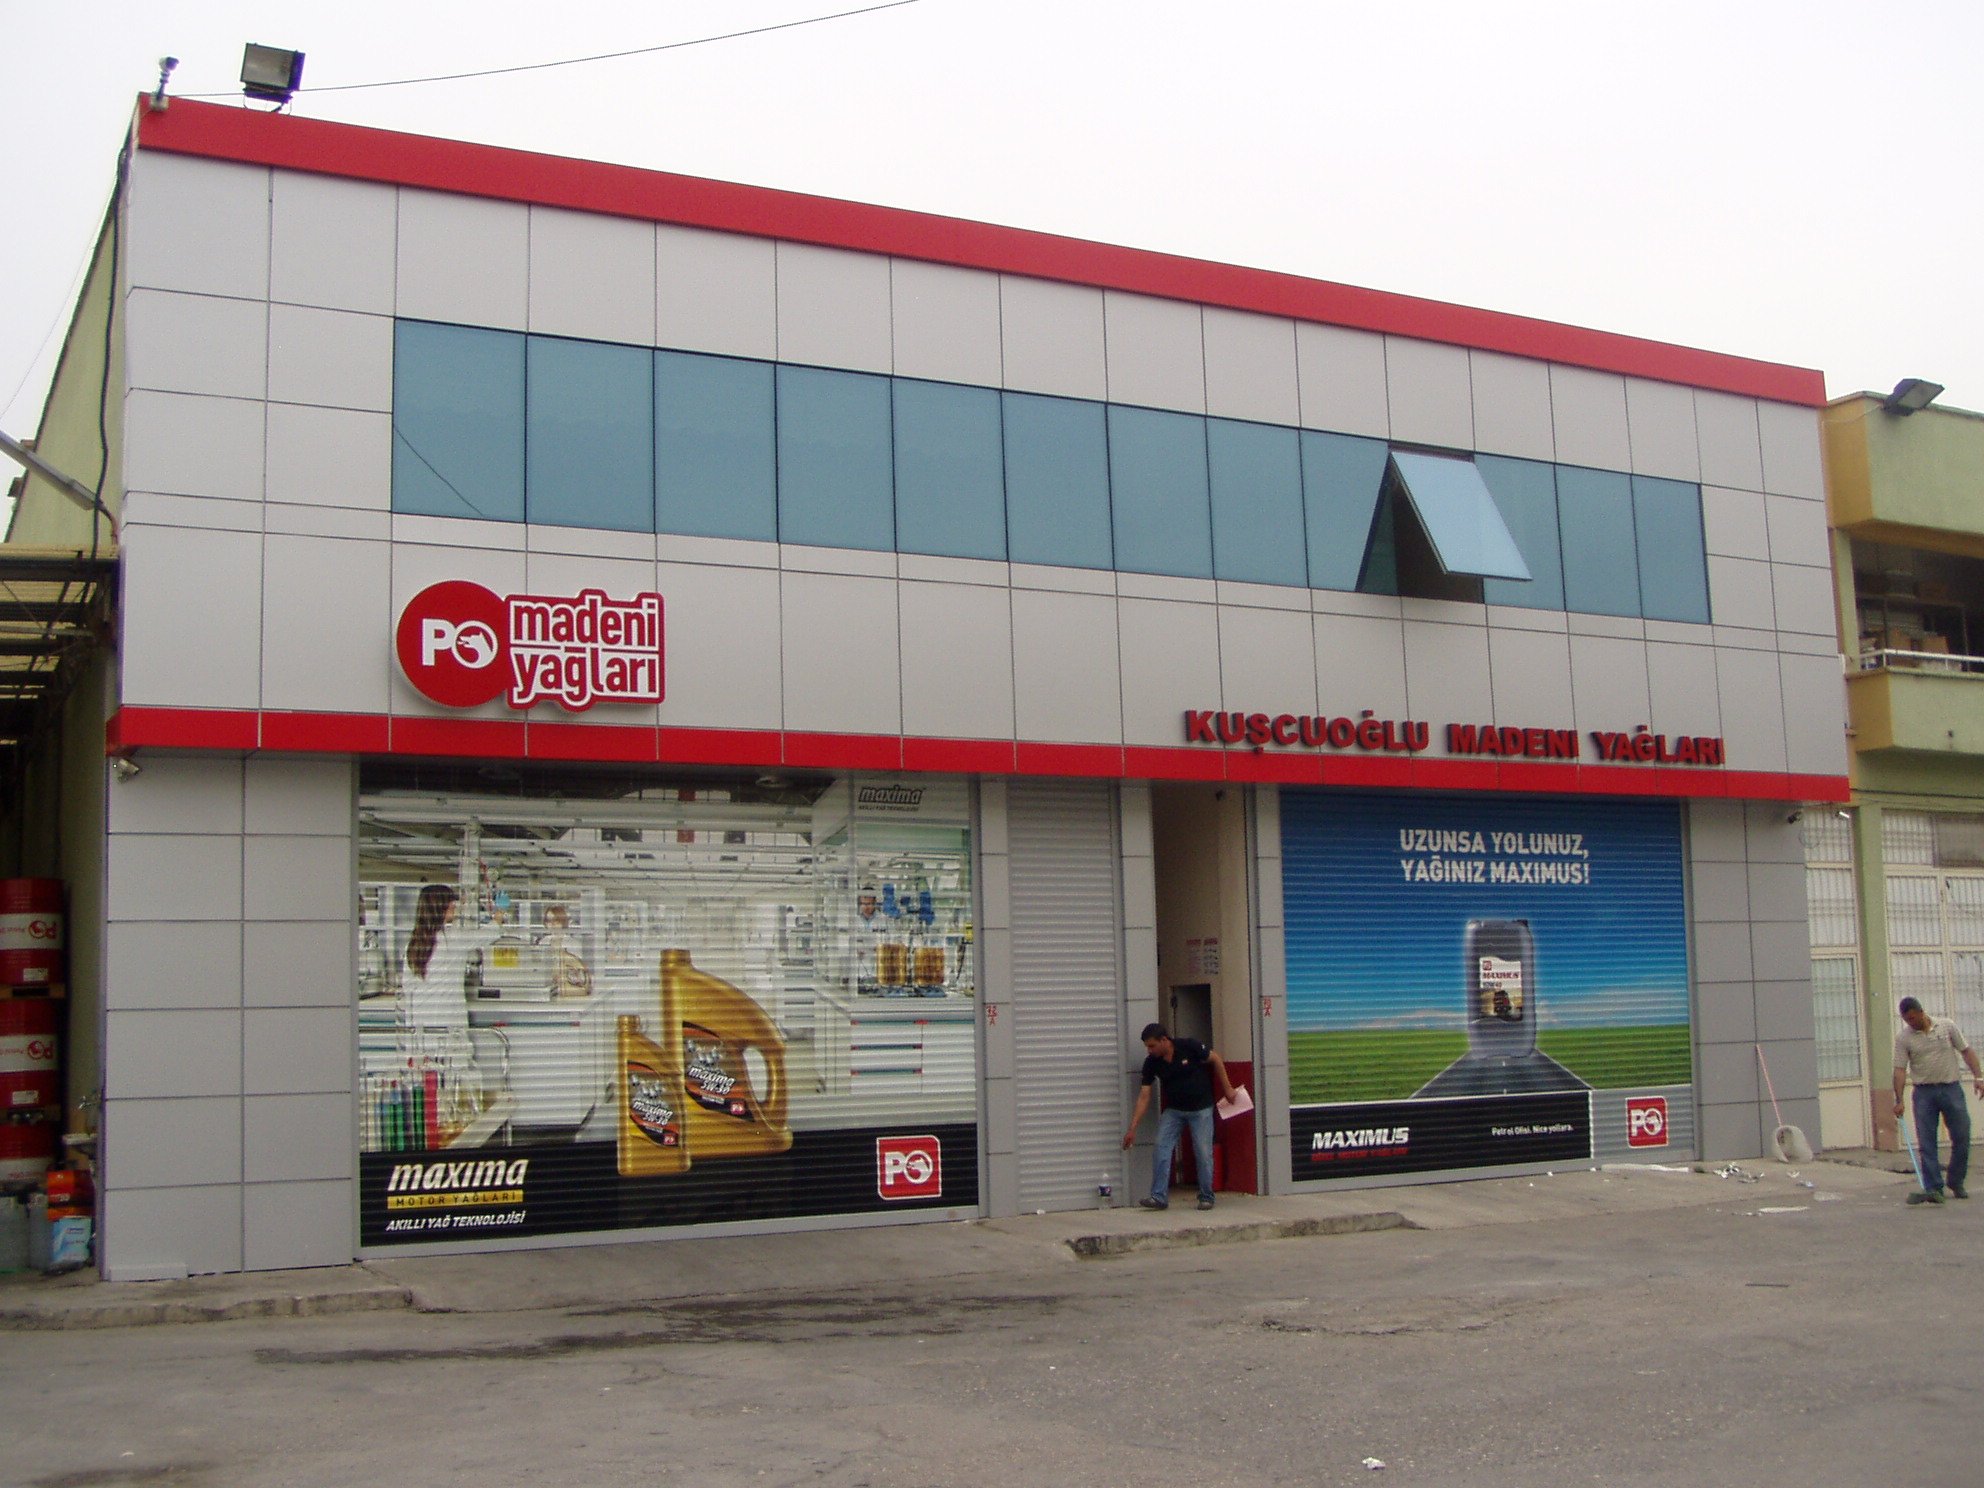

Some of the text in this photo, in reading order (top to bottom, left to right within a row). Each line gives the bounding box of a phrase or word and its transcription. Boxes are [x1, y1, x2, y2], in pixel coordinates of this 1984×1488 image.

[514, 598, 656, 648] madeni
[1185, 710, 1429, 755] KUŞCUOĞLU
[1591, 725, 1725, 765] YAĞLARI
[858, 785, 923, 804] maxima
[1399, 829, 1590, 859] UZUNSA YOLUNUZ,
[1400, 855, 1590, 884] YAĞINIZ MAXIMUS!
[1312, 1127, 1410, 1149] MAXIMUS
[885, 1150, 933, 1186] PO
[397, 1197, 446, 1207] MOTOR
[386, 1219, 425, 1232] AKILLI
[427, 1214, 451, 1229] YAĞ
